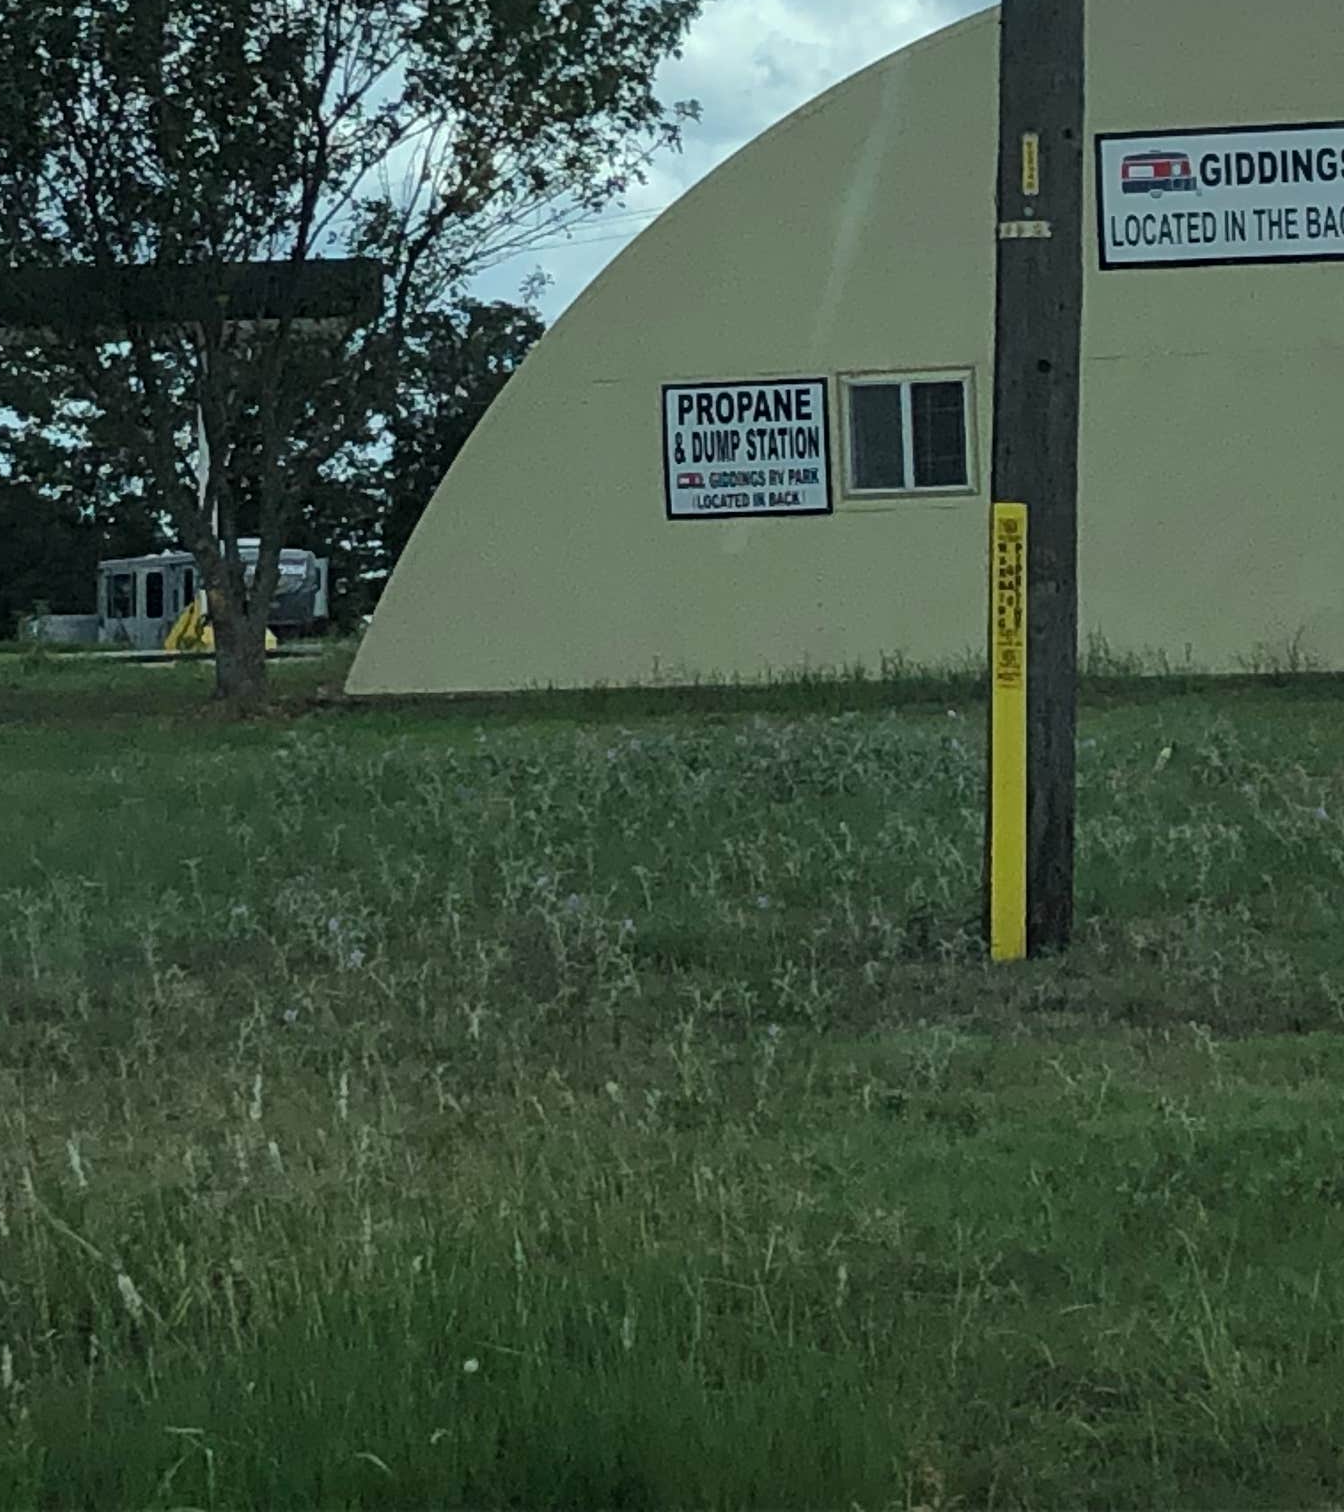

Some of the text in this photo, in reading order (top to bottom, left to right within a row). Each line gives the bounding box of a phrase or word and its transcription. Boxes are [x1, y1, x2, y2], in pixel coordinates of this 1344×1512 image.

[1110, 211, 1216, 247] LOCATED
[1224, 209, 1247, 242] IN
[1253, 207, 1300, 241] THE
[677, 388, 813, 425] PROPANE
[674, 426, 820, 465] & DUMP STATION
